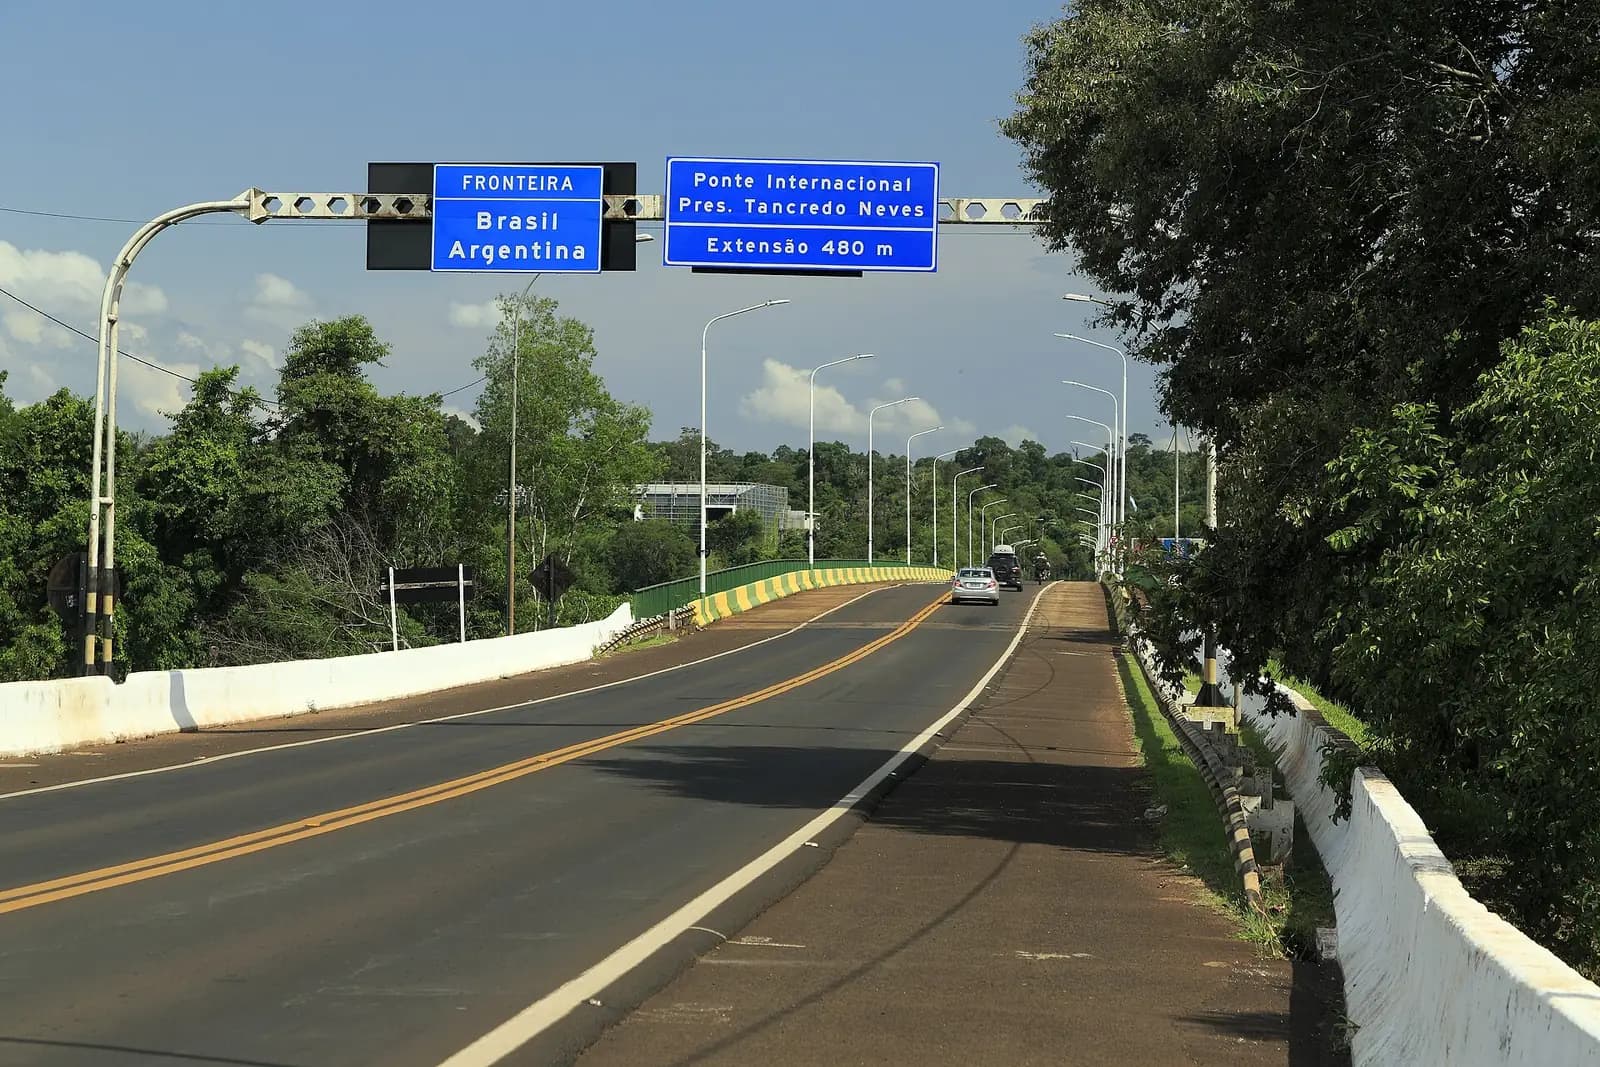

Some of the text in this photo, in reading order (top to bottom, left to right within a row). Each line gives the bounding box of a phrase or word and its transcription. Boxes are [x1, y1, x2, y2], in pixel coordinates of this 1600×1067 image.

[462, 175, 573, 191] FRONTEIRA
[694, 172, 911, 192] Ponte Internacional
[679, 197, 924, 217] Pres. Tancredo Neves
[476, 211, 558, 230] Brasil
[448, 240, 585, 265] Argentina
[707, 237, 893, 256] Extensão 480 m
